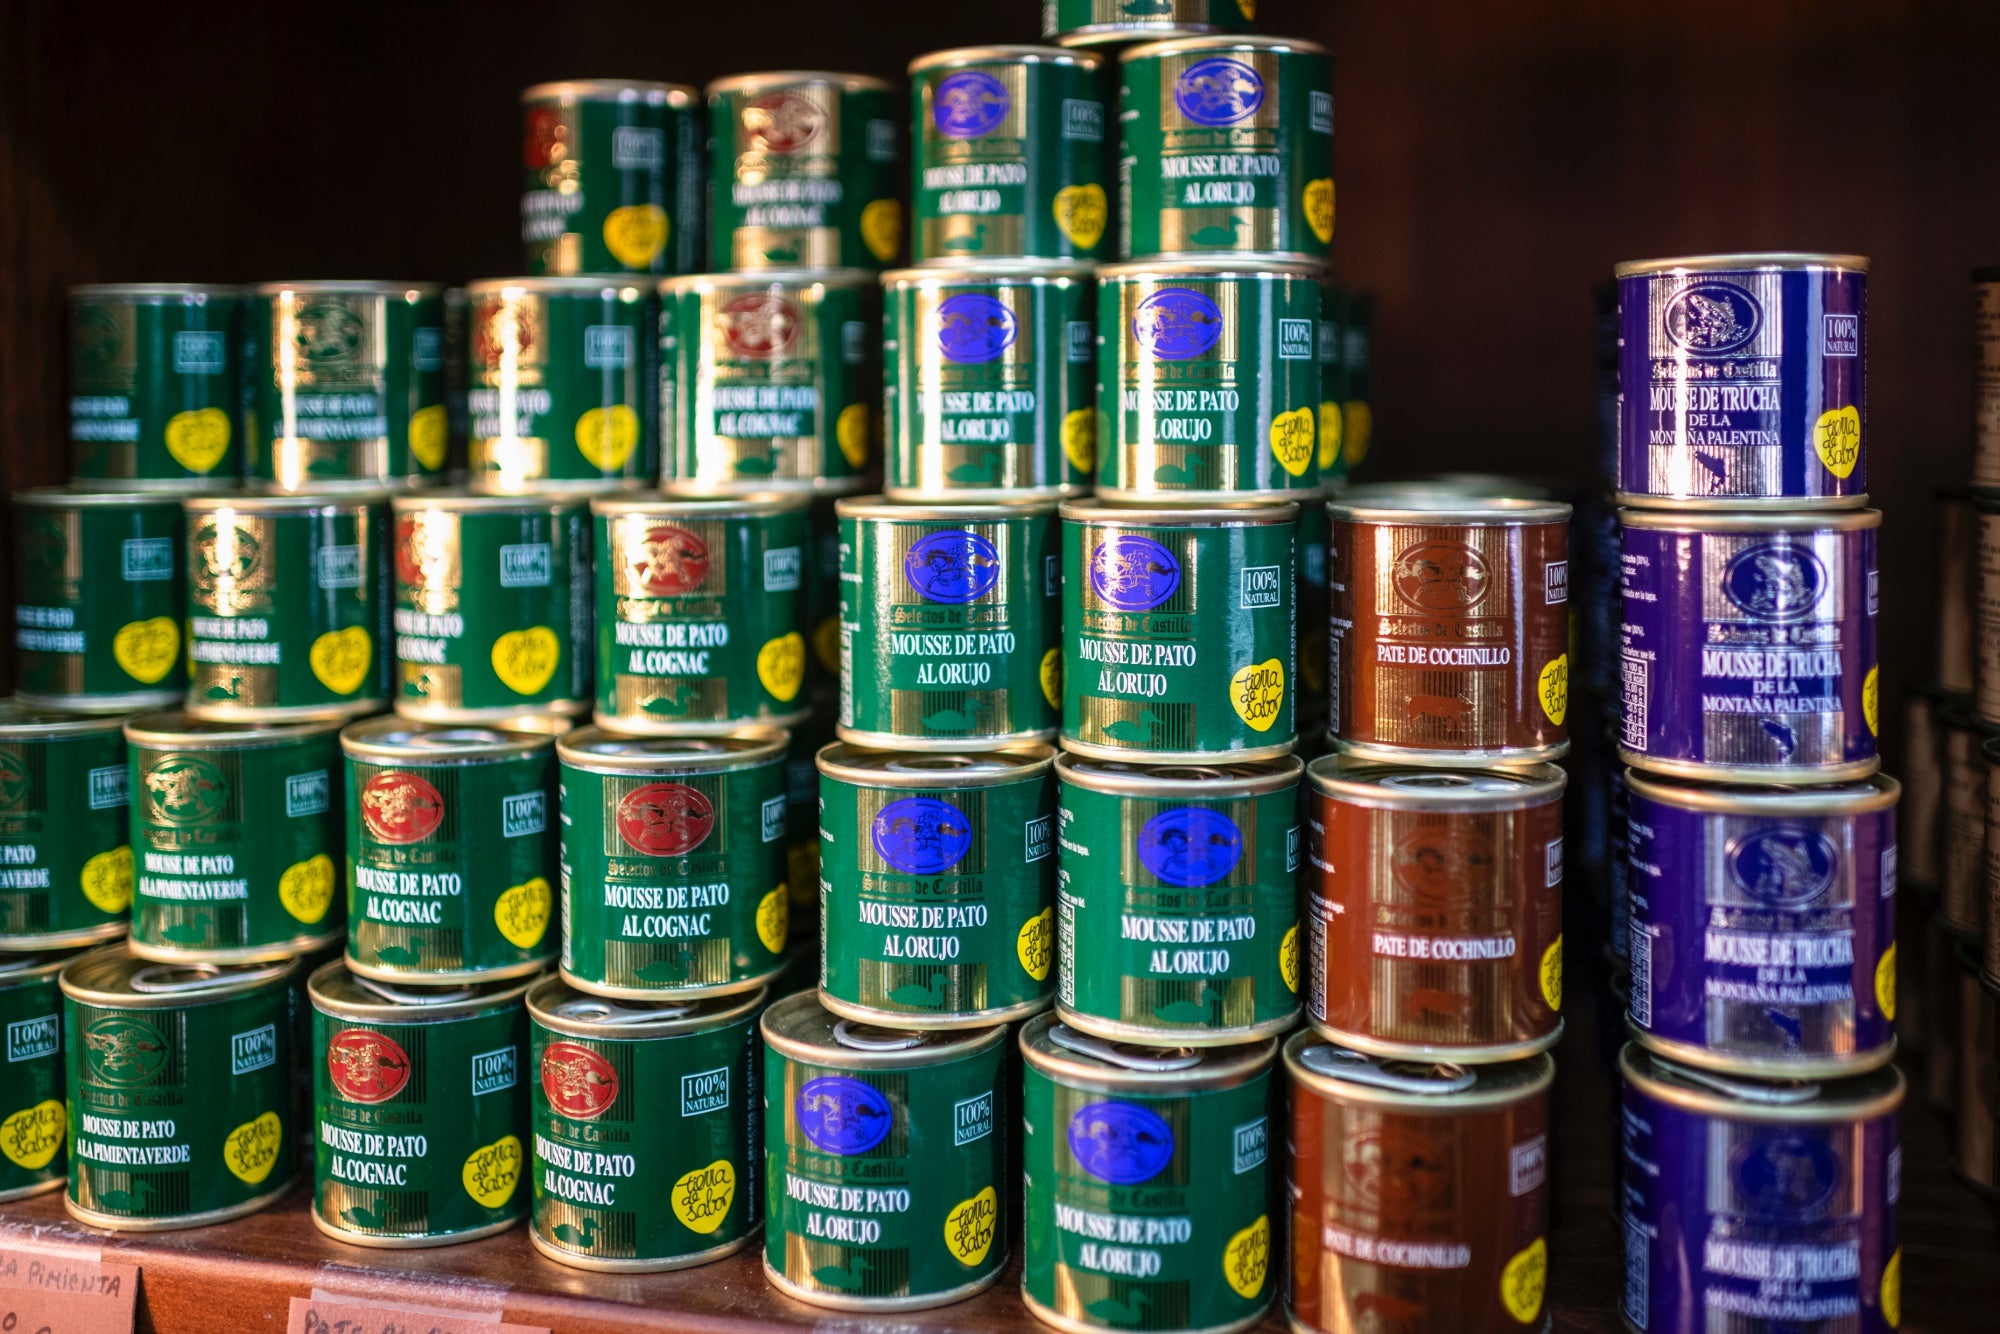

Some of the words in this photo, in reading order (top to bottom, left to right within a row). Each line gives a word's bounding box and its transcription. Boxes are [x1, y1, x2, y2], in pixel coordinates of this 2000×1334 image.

[1162, 155, 1217, 179] MOUSSE
[1220, 155, 1241, 177] DE
[1242, 155, 1279, 177] PATO
[1204, 182, 1255, 204] ORUJO
[1283, 323, 1310, 343] 100%
[1827, 319, 1856, 339] 100%
[1827, 341, 1856, 352] NATURAL
[1176, 390, 1197, 411] DE
[1199, 390, 1240, 411] PATO
[1700, 387, 1720, 411] DE
[1721, 386, 1781, 411] TRUCHA
[1161, 418, 1212, 442] ORUJO
[1689, 414, 1708, 426] DE
[1711, 414, 1731, 426] LA
[1707, 430, 1781, 445] PALENTINA
[1247, 570, 1278, 592] 100%
[1244, 591, 1278, 604] NATURAL
[894, 606, 945, 625] Selectos
[948, 607, 962, 624] de
[1124, 614, 1139, 632] de
[1142, 615, 1192, 634] Castilla
[615, 620, 665, 647] MOUSSE
[666, 623, 687, 647] DE
[689, 623, 729, 647] PATO
[891, 634, 952, 656] MOUSSE
[954, 634, 977, 656] DE
[979, 632, 1016, 655] PATO
[647, 651, 710, 675] COGNAC
[1079, 637, 1129, 664] MOUSSE
[1131, 644, 1153, 666] DE
[1154, 644, 1197, 667] PATO
[1377, 645, 1406, 664] PATE
[1409, 646, 1427, 664] DE
[1428, 647, 1511, 665] COCHINILLO
[1702, 650, 1763, 678] MOUSSE
[1764, 651, 1788, 678] DE
[1788, 650, 1843, 678] TRUCHA
[916, 663, 938, 684] AL
[938, 662, 991, 686] ORUJO
[1097, 672, 1117, 694] AL
[1116, 673, 1168, 698] ORUJO
[1235, 669, 1282, 692] tierra
[1753, 680, 1775, 694] DE
[1777, 680, 1800, 694] LA
[1702, 693, 1773, 713] MONTAÑA
[1773, 696, 1843, 713] PALENTINA
[201, 854, 234, 875] PATO
[356, 864, 398, 895] MOUSSE
[399, 873, 419, 896] DE
[421, 872, 461, 896] PATO
[914, 878, 929, 895] de
[604, 884, 664, 909] MOUSSE
[666, 887, 689, 909] DE
[690, 883, 730, 909] PATO
[366, 896, 382, 919] AL
[381, 899, 442, 923] COGNAC
[859, 900, 919, 929] MOUSSE
[921, 906, 944, 929] DE
[947, 904, 988, 929] PATO
[621, 914, 643, 937] AL
[643, 914, 711, 938] COGNAC
[1121, 915, 1190, 943] MOUSSE
[1191, 919, 1215, 943] DE
[1217, 916, 1256, 942] PATO
[883, 934, 905, 956] AL
[905, 936, 960, 961] ORUJO
[1373, 934, 1407, 957] PATE
[1409, 937, 1430, 958] DE
[1432, 937, 1517, 960] COCHINILLO
[1150, 949, 1173, 973] AL
[1173, 949, 1230, 976] ORUJO
[14, 1022, 56, 1047] 100%
[237, 1033, 273, 1058] 100%
[478, 1055, 514, 1079] 100%
[687, 1072, 726, 1100] 100%
[686, 1095, 726, 1112] NATURAL
[959, 1101, 990, 1127] 100%
[83, 1113, 122, 1138] MOUSSE
[123, 1120, 141, 1139] DE
[142, 1119, 176, 1139] PATO
[569, 1122, 580, 1139] de
[958, 1120, 991, 1141] NATURAL
[321, 1119, 363, 1155] MOUSSE
[364, 1134, 384, 1157] DE
[386, 1135, 428, 1158] PATO
[535, 1132, 573, 1171] MOUSSE
[573, 1149, 593, 1175] DE
[595, 1152, 636, 1178] PATO
[331, 1154, 346, 1178] AL
[346, 1157, 407, 1186] COGNAC
[676, 1167, 732, 1193] tierra
[851, 1159, 905, 1178] Castilla
[544, 1168, 557, 1194] AL
[557, 1174, 615, 1206] COGNAC
[681, 1189, 701, 1206] de
[786, 1173, 839, 1210] MOUSSE
[841, 1186, 865, 1213] DE
[866, 1188, 911, 1213] PATO
[687, 1187, 732, 1222] sabor
[950, 1199, 996, 1226] tierra
[806, 1212, 825, 1236] AL
[825, 1216, 880, 1246] ORUJO
[1054, 1202, 1117, 1242] MOUSSE
[1118, 1218, 1144, 1245] DE
[1145, 1217, 1192, 1245] PATO
[1079, 1243, 1101, 1269] AL
[1101, 1248, 1162, 1279] ORUJO
